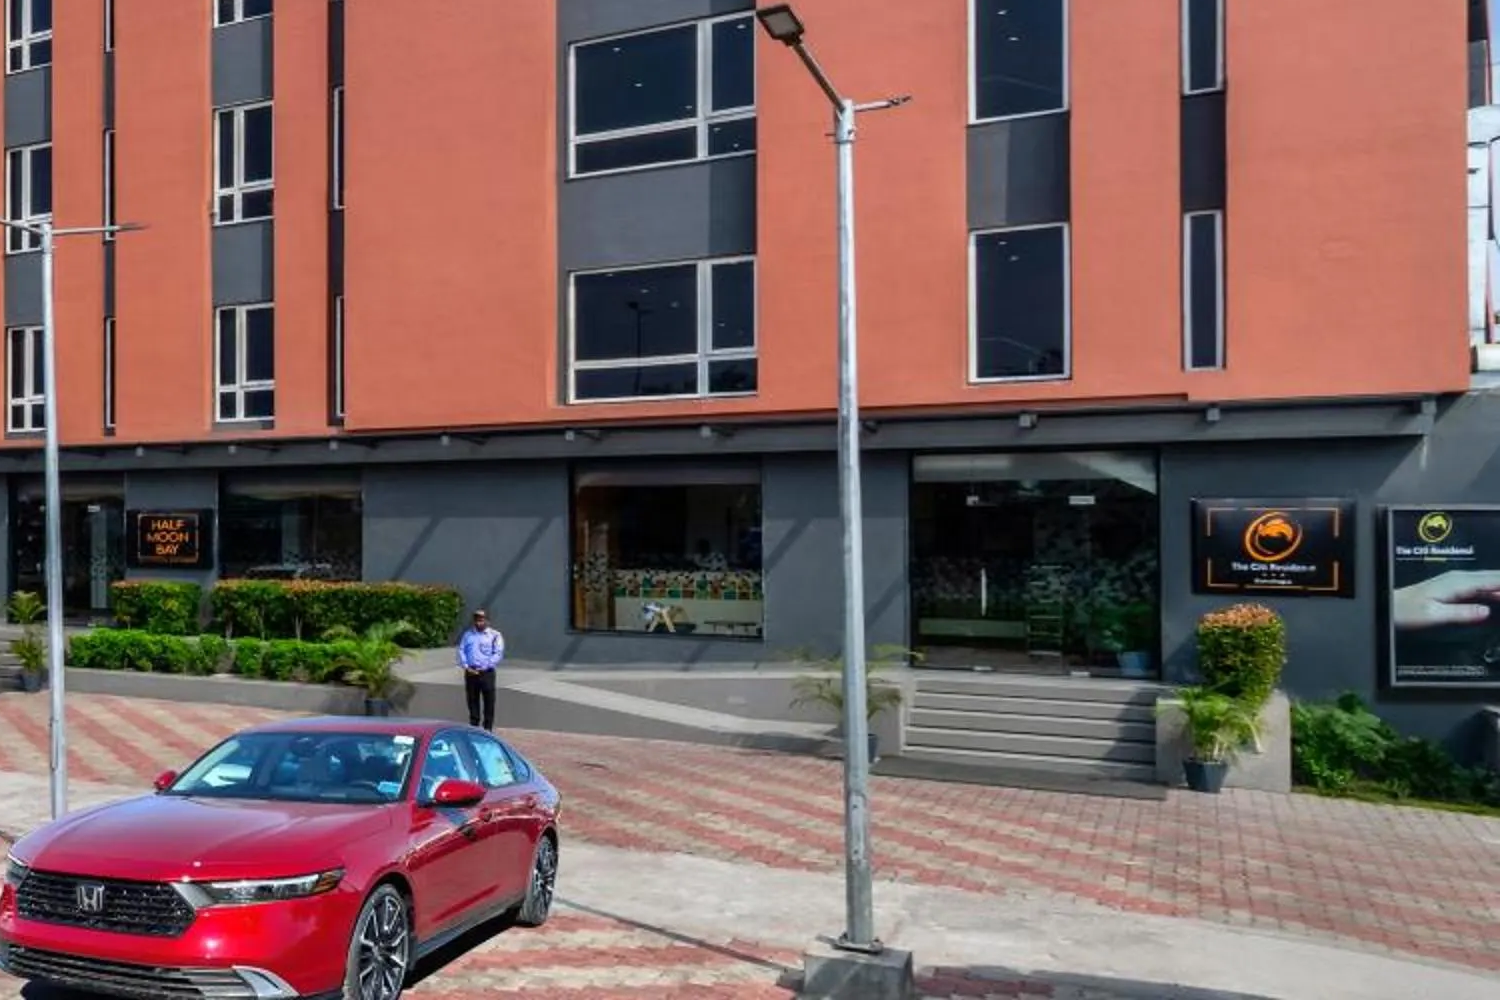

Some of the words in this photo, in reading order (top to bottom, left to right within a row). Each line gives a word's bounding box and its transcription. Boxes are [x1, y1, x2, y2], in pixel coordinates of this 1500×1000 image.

[152, 520, 185, 531] HALF
[146, 531, 189, 542] MOON
[155, 543, 179, 555] BAY
